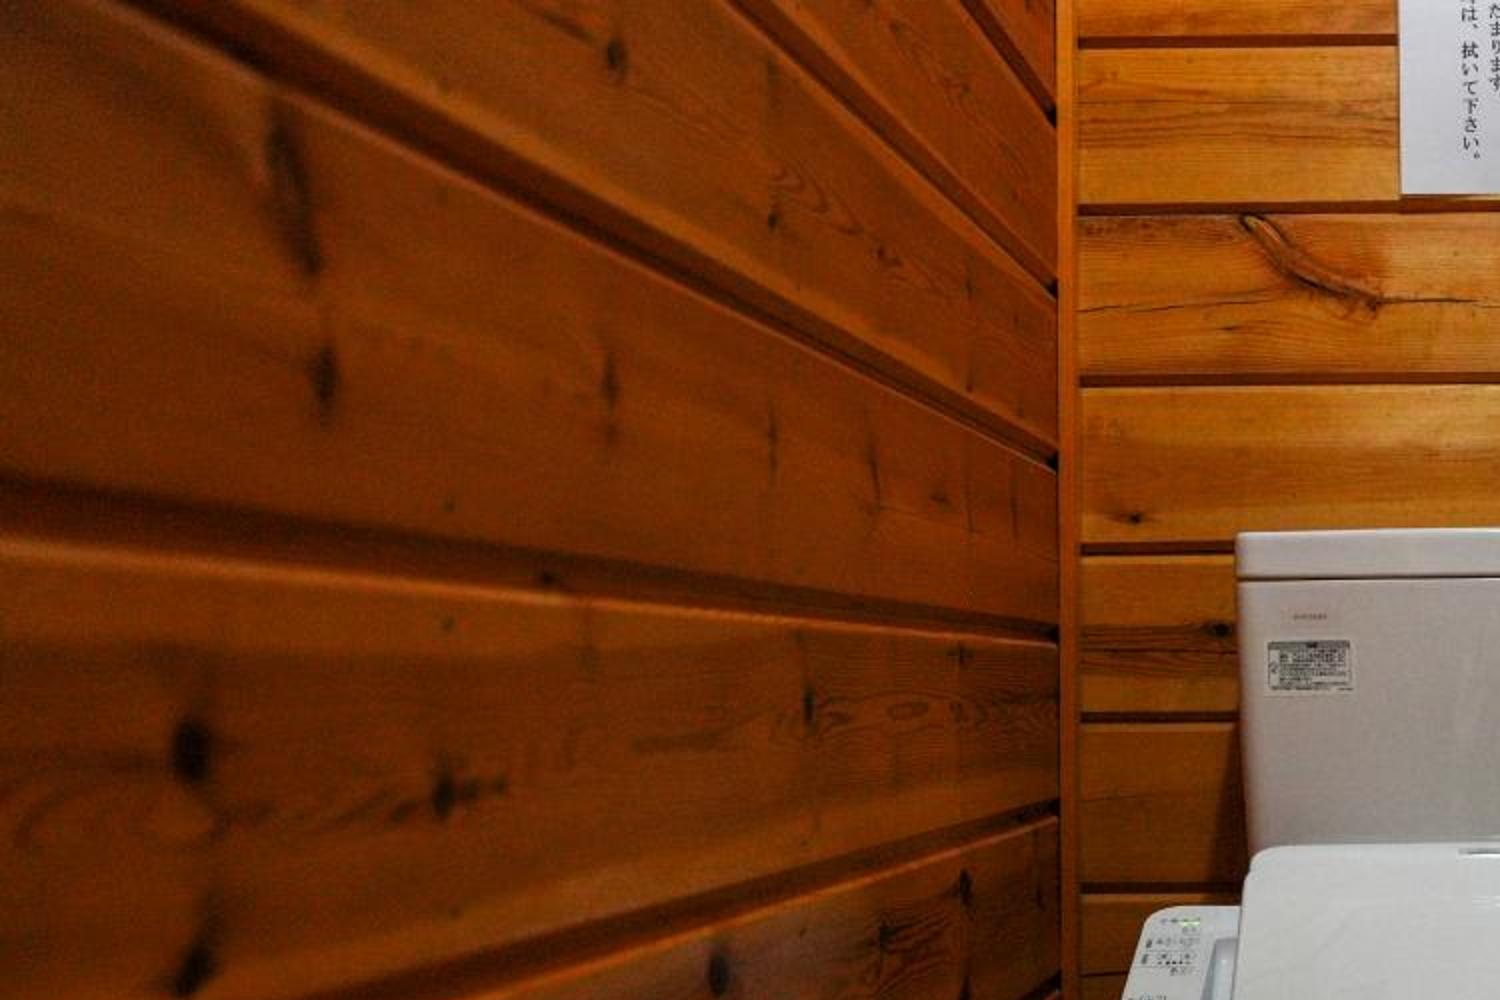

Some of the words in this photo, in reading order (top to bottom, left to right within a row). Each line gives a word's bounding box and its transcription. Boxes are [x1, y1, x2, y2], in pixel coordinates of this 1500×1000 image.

[1461, 0, 1480, 159] は、拭いて下さい。
